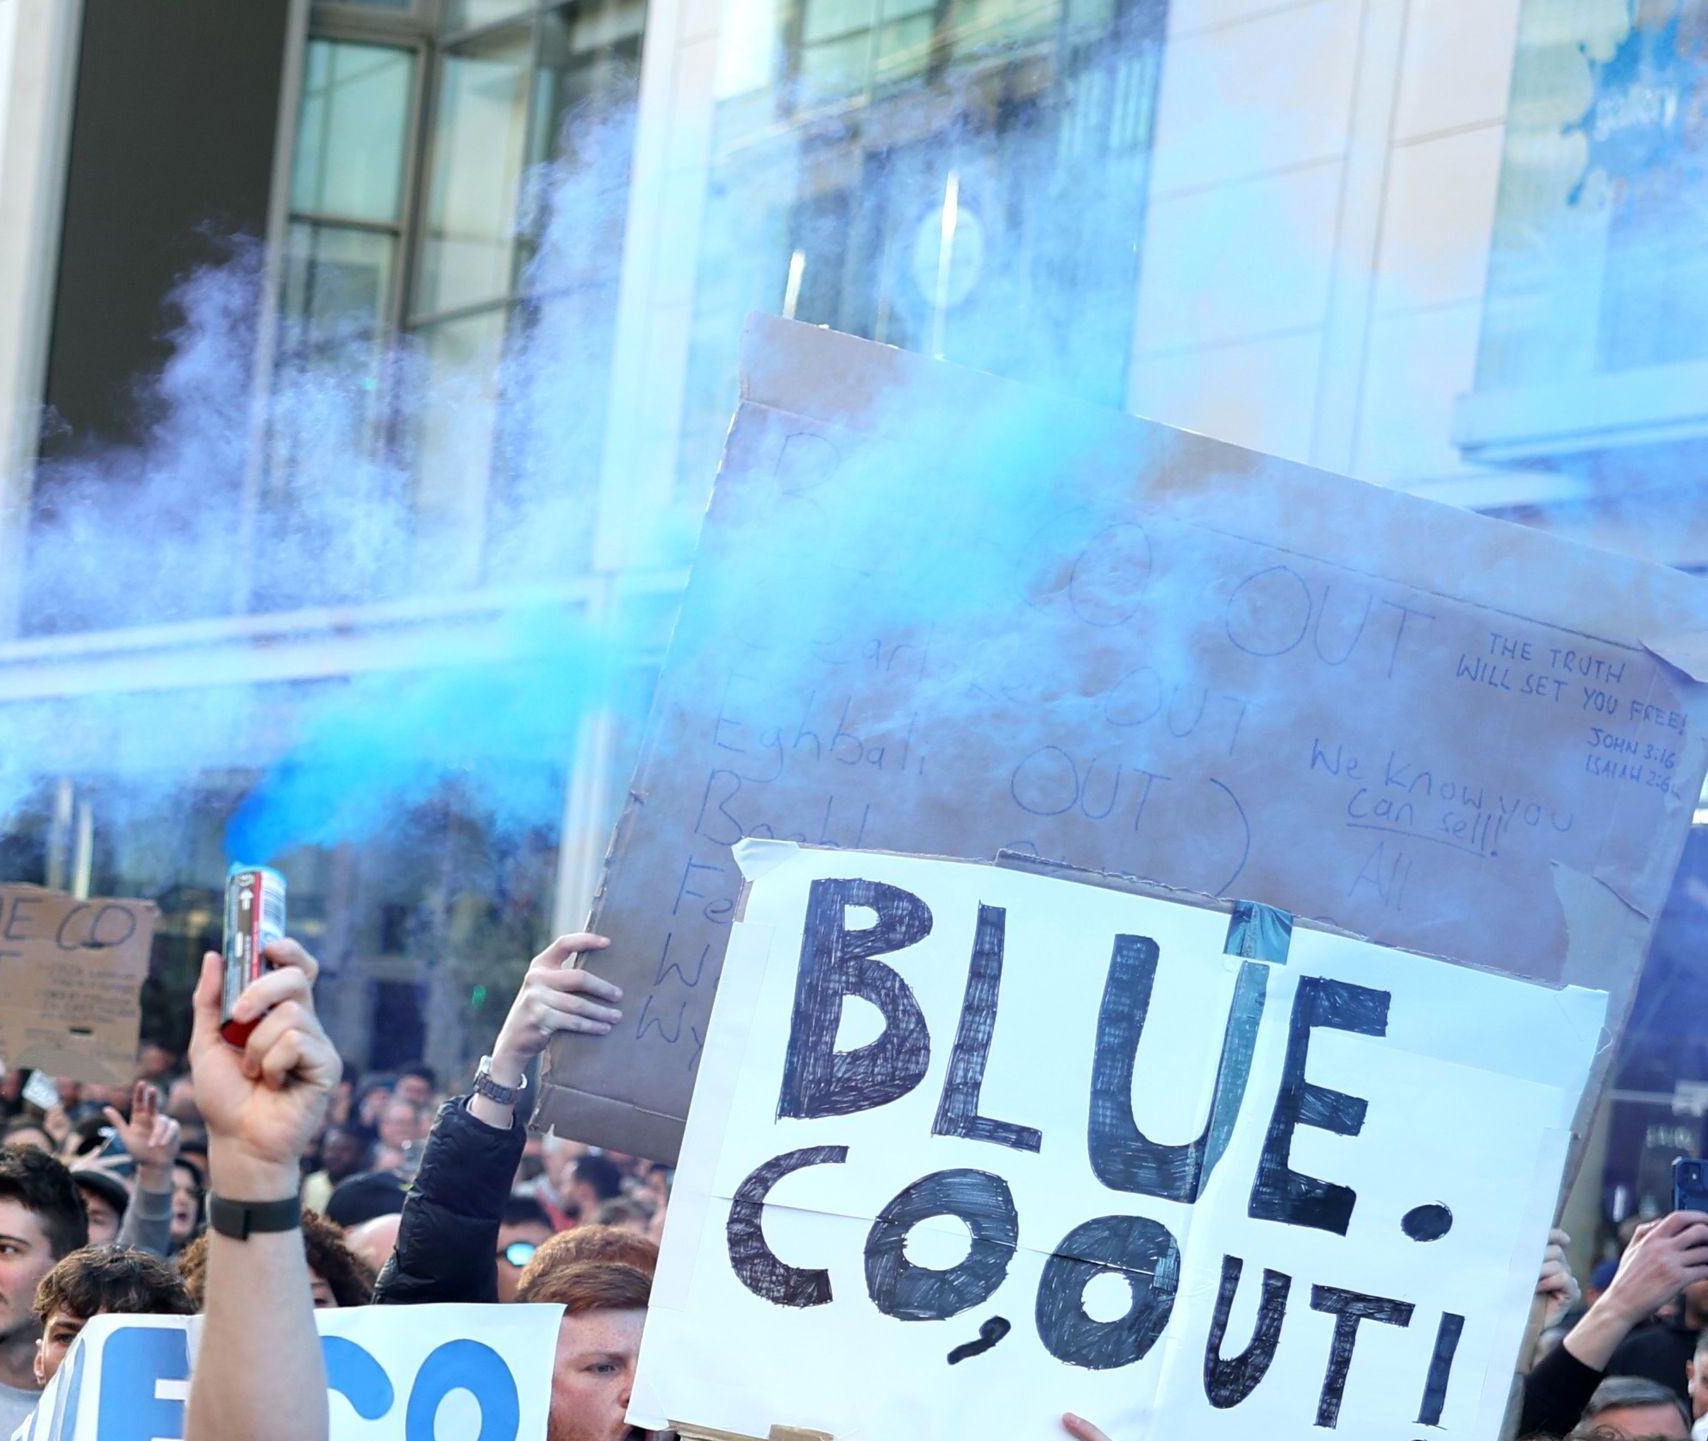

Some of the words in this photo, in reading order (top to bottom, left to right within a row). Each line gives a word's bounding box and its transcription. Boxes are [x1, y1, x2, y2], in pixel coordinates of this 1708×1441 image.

[1455, 653, 1513, 692] WILL
[1523, 672, 1569, 704] SET
[1584, 686, 1620, 717] YOU
[1489, 632, 1533, 662] THE
[1550, 648, 1627, 685] TRUTH
[1586, 727, 1639, 756] JOHN
[774, 876, 1454, 1242] BLUE.
